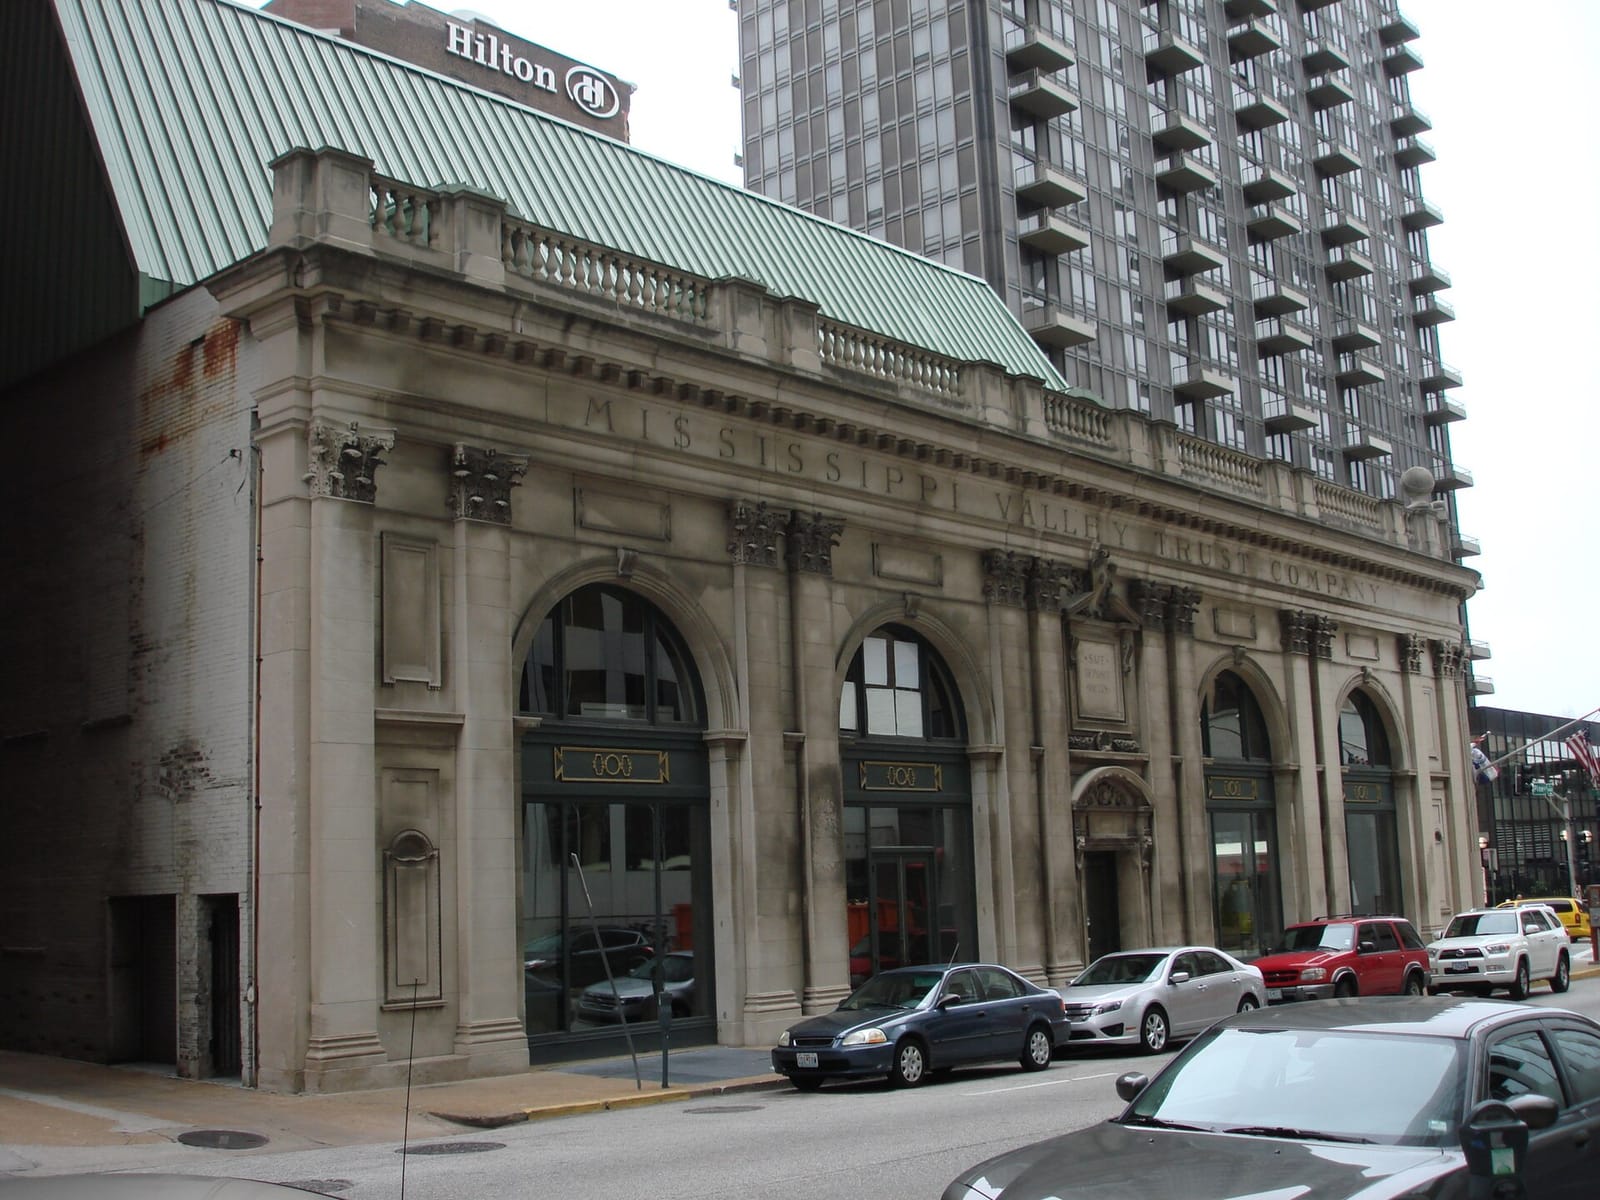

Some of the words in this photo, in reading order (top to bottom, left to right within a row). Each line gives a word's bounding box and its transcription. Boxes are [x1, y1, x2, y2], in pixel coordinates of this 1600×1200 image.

[446, 20, 558, 94] Hilton
[585, 398, 957, 512] MISSISSIPPI
[995, 492, 1129, 546] VALLEY
[1153, 530, 1251, 575] TRUST
[1271, 559, 1380, 604] COMPANY
